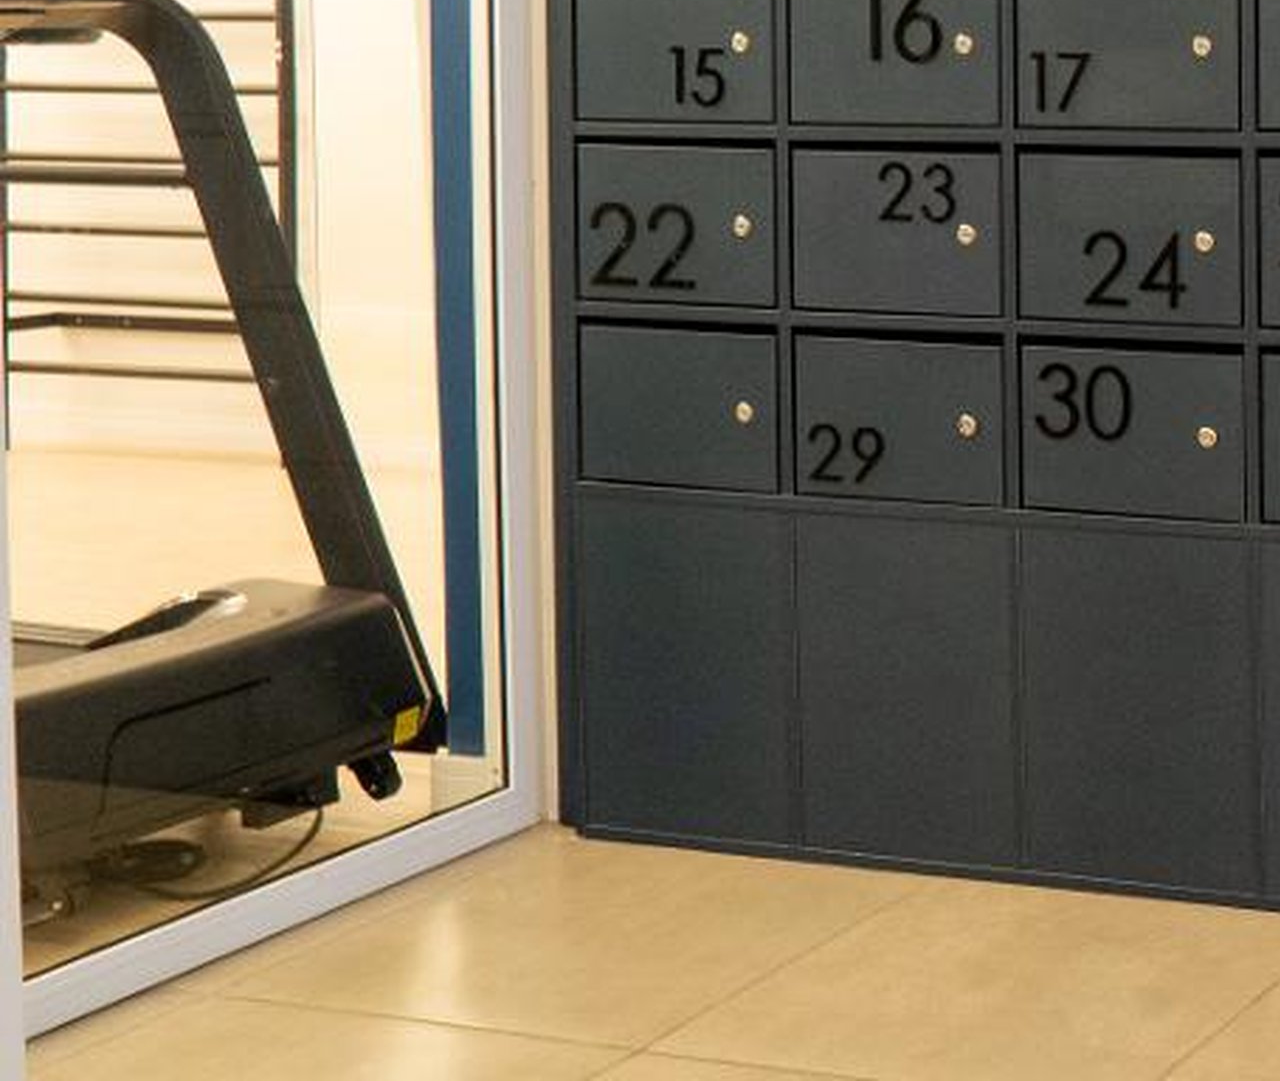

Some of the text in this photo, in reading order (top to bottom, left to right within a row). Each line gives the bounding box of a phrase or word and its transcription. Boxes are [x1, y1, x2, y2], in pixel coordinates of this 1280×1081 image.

[670, 46, 726, 108] 15
[1030, 51, 1091, 113] 17
[878, 162, 956, 223] 23
[589, 202, 696, 290] 22
[1083, 230, 1187, 309] 24
[1034, 363, 1132, 441] 30
[807, 424, 886, 486] 29
